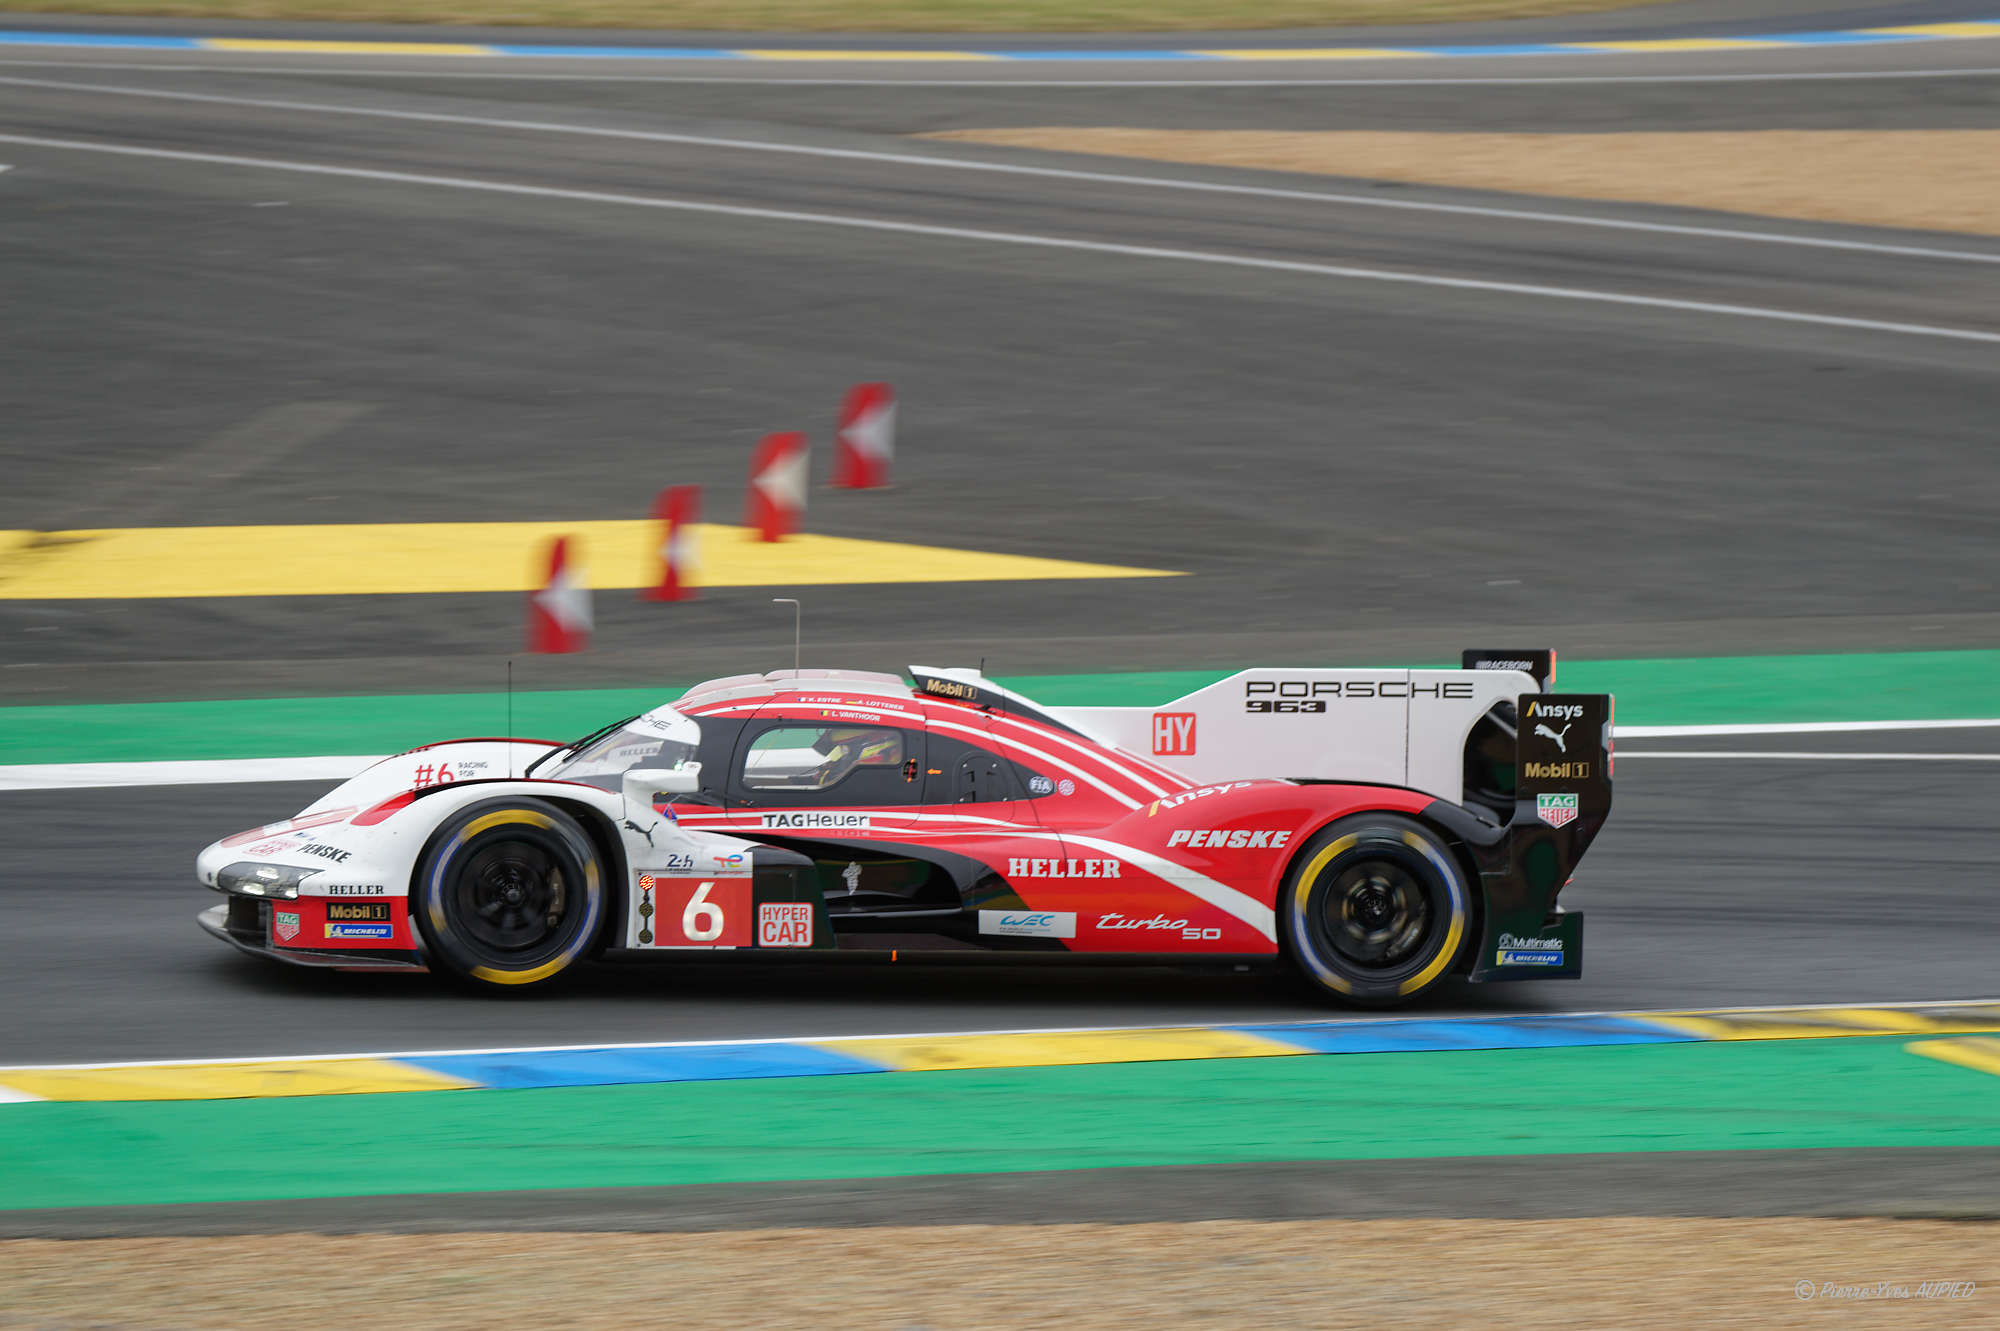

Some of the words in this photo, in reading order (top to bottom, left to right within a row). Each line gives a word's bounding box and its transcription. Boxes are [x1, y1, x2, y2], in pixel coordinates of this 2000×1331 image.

[927, 679, 963, 696] Mobil
[1246, 682, 1474, 698] PORSCHE
[1246, 701, 1326, 712] 963
[1527, 701, 1583, 720] Ansys
[1155, 716, 1193, 752] HY
[413, 763, 454, 787] #6
[1525, 762, 1571, 778] Mobil
[1148, 782, 1252, 818] Ansys
[1542, 796, 1574, 806] TAG
[1540, 807, 1576, 825] HEUER
[1167, 830, 1291, 849] PENSKE
[297, 843, 352, 863] PENSKE
[1008, 858, 1121, 878] HELLER
[329, 885, 384, 895] HELLER
[279, 914, 297, 924] TAG
[330, 905, 370, 919] Mobil
[682, 882, 724, 941] 6
[763, 907, 808, 920] HYPER
[1000, 914, 1055, 926] WEC
[763, 922, 807, 942] CAR
[1096, 913, 1188, 930] turbo
[1182, 928, 1221, 940] 50
[1513, 937, 1563, 949] Multimatic
